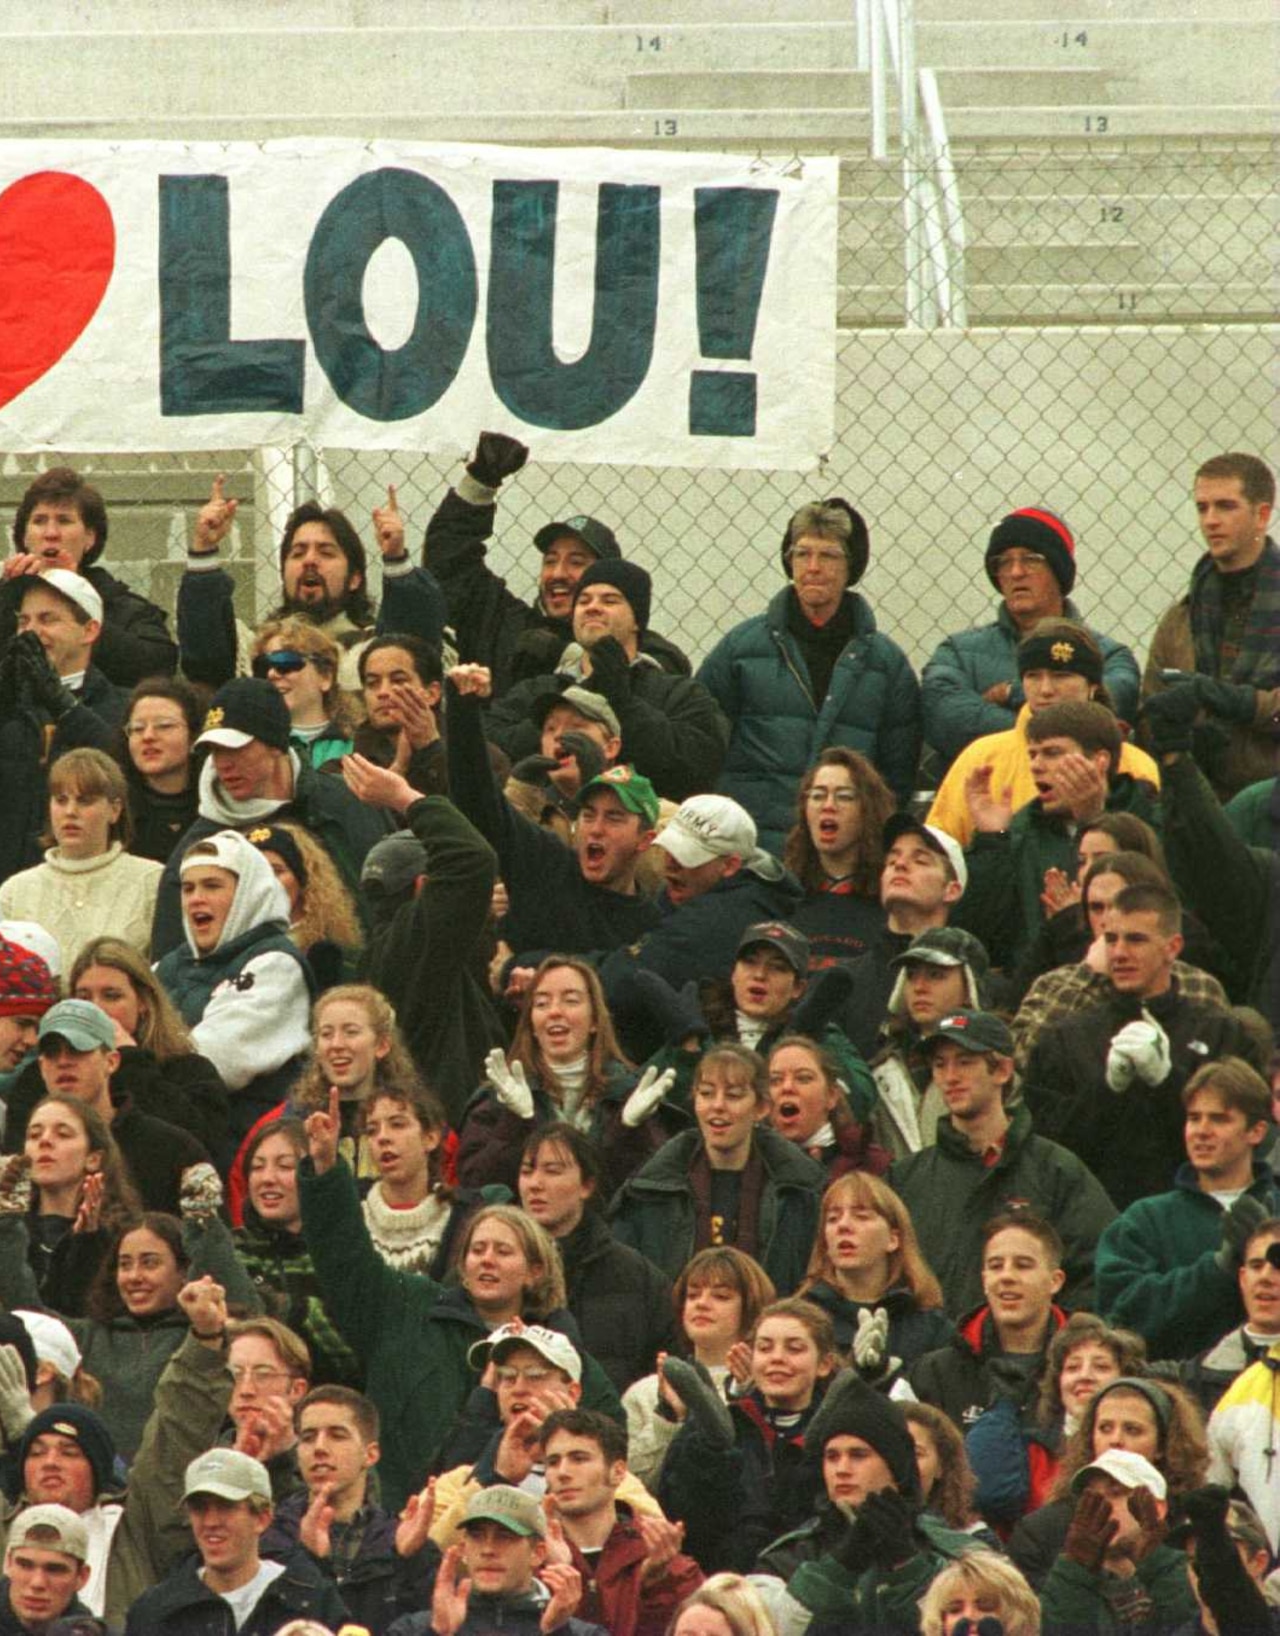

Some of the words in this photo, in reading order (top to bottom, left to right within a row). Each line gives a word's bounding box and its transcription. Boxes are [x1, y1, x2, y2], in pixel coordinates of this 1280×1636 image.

[635, 36, 661, 52] 14
[1062, 31, 1088, 47] 14
[653, 120, 678, 136] 13
[1084, 116, 1108, 132] 13
[1100, 207, 1123, 222] 12
[158, 167, 780, 436] LOU!
